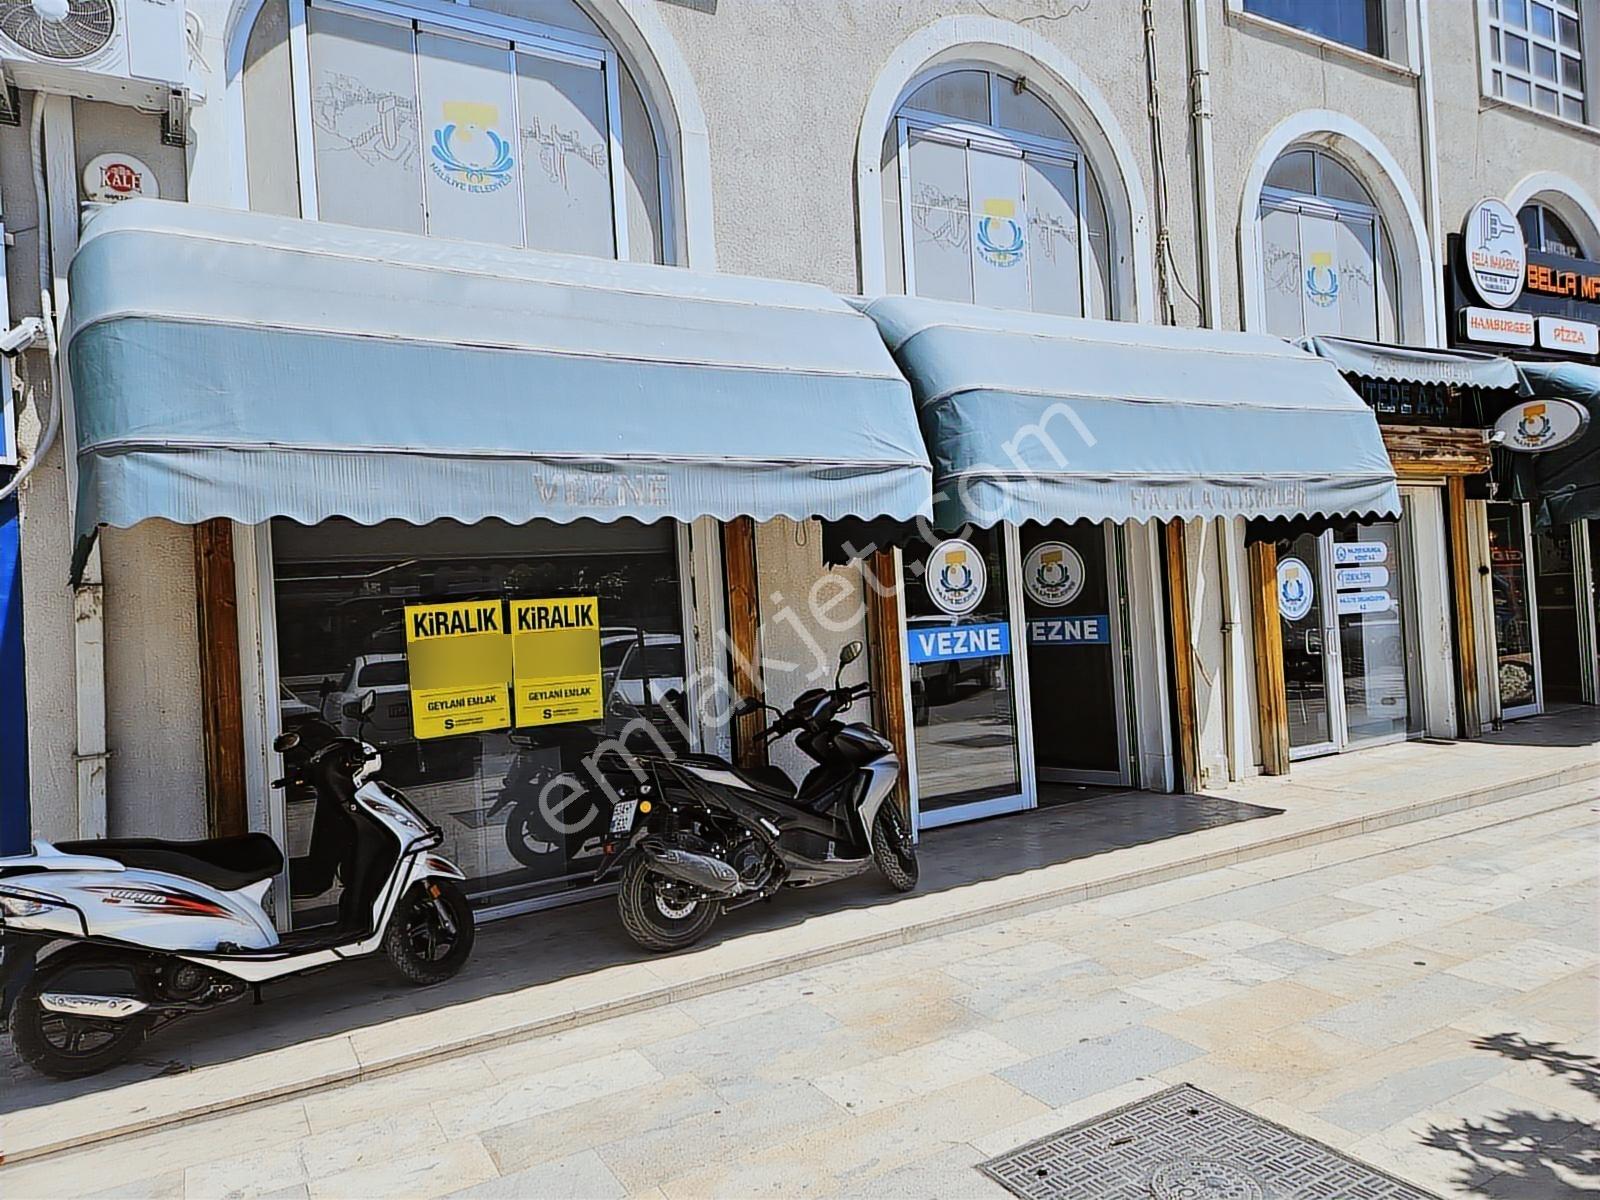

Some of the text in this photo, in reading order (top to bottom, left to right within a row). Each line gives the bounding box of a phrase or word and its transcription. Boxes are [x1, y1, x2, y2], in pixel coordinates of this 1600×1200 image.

[100, 166, 142, 193] KALE
[1527, 264, 1577, 296] BELLA
[1471, 316, 1532, 334] HAMBURGER
[533, 474, 668, 506] VEZNE
[1025, 619, 1099, 641] EZNE
[919, 628, 1001, 657] VEZNE
[466, 695, 497, 706] EMLAK
[564, 687, 592, 697] EMLAK
